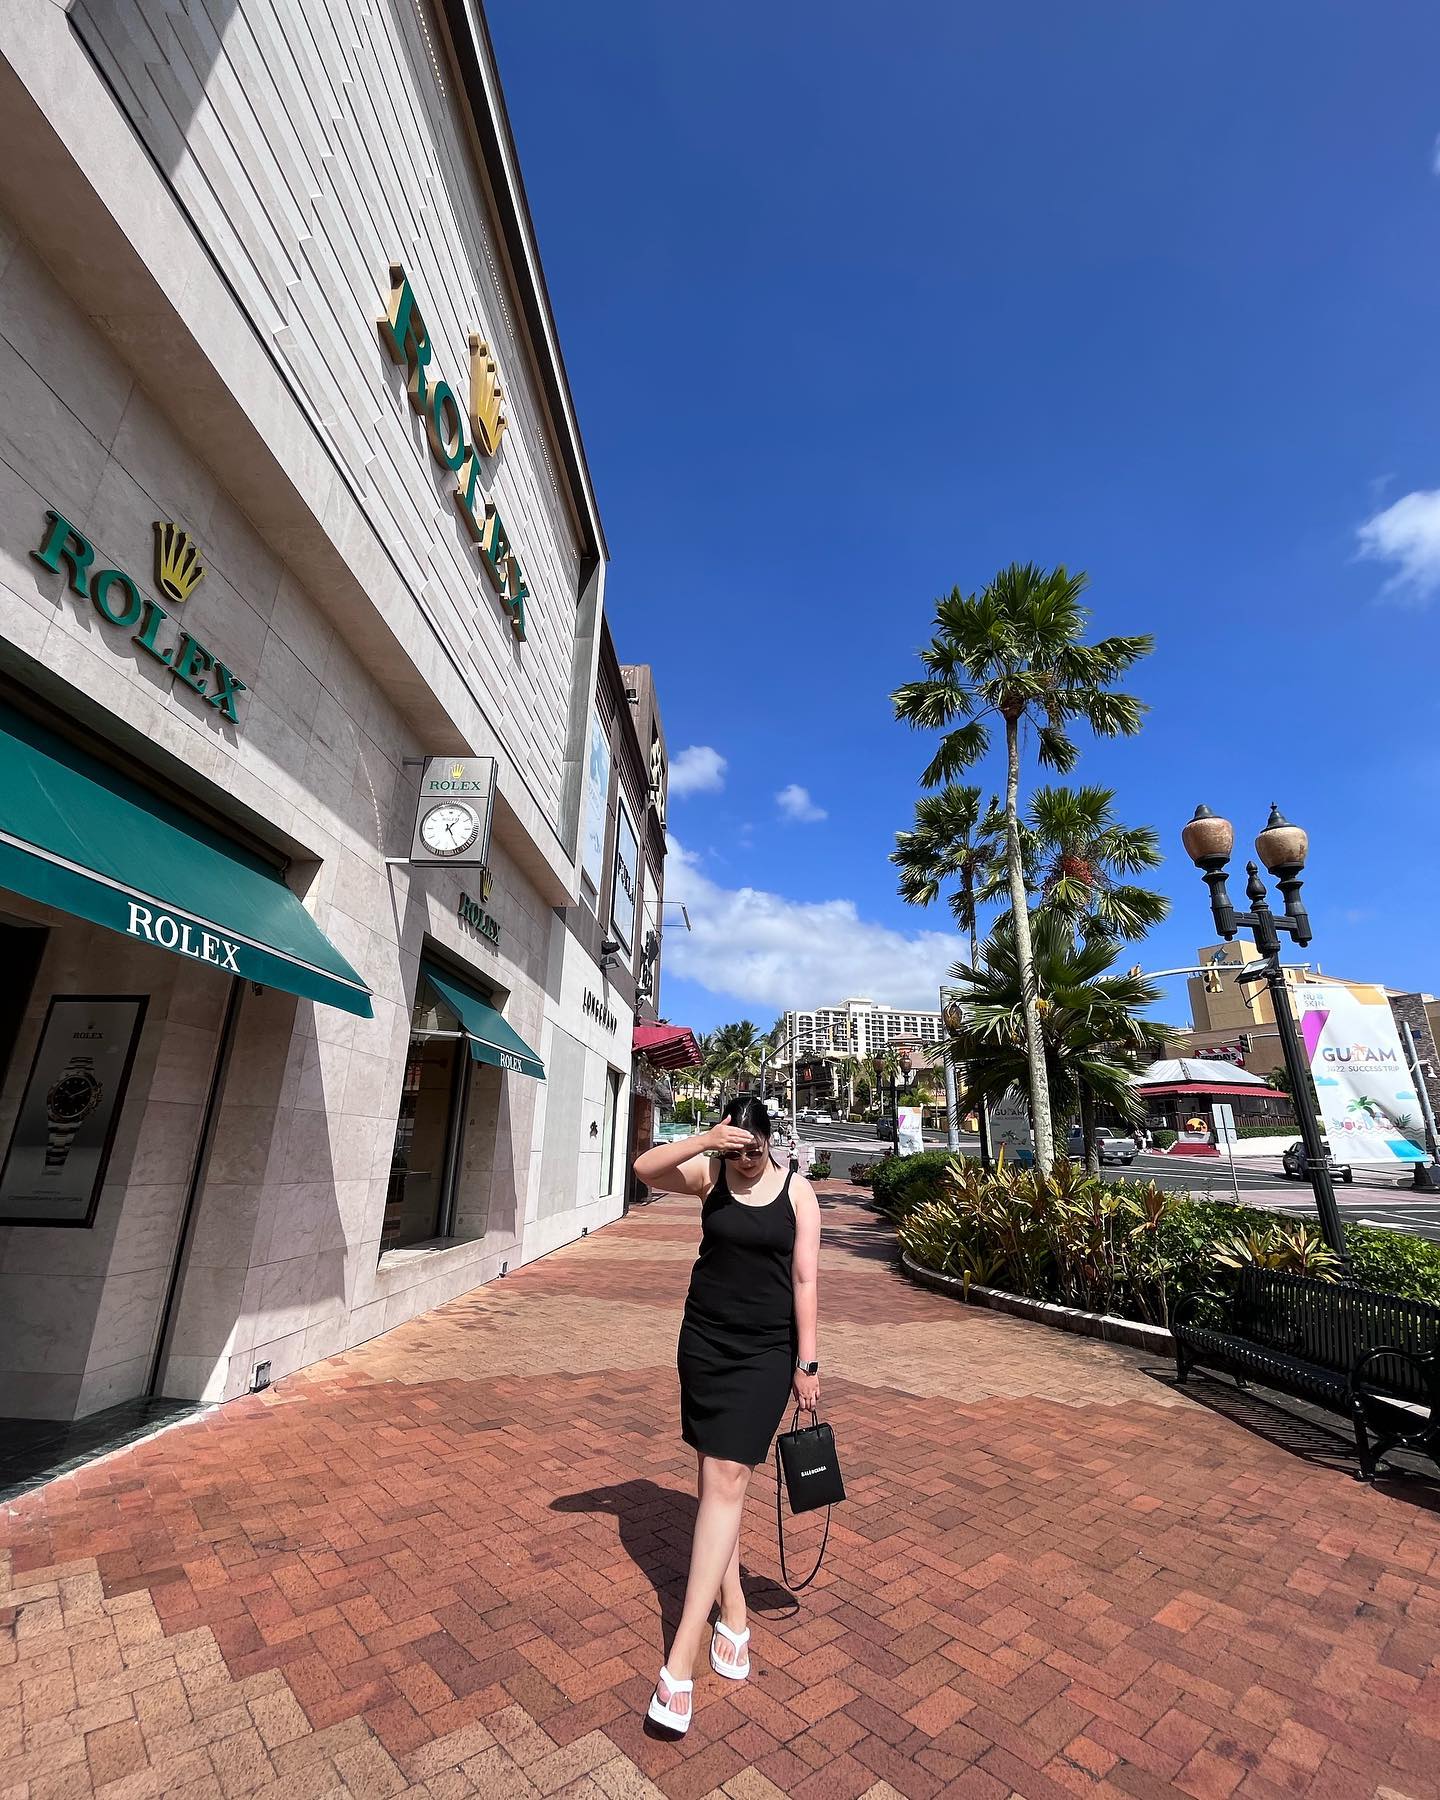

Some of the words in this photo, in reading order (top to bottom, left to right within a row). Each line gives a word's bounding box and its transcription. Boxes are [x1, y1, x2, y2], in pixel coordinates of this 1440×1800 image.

[376, 260, 530, 642] ROLEX
[29, 510, 247, 725] ROLEX
[429, 780, 481, 791] ROLEX
[126, 901, 240, 973] ROLEX
[457, 891, 501, 947] ROLEX
[582, 987, 618, 1036] LONGCHAMP
[500, 1052, 523, 1073] ROLEX
[1322, 1047, 1397, 1062] GUAM
[1348, 1065, 1382, 1073] SUCCESS
